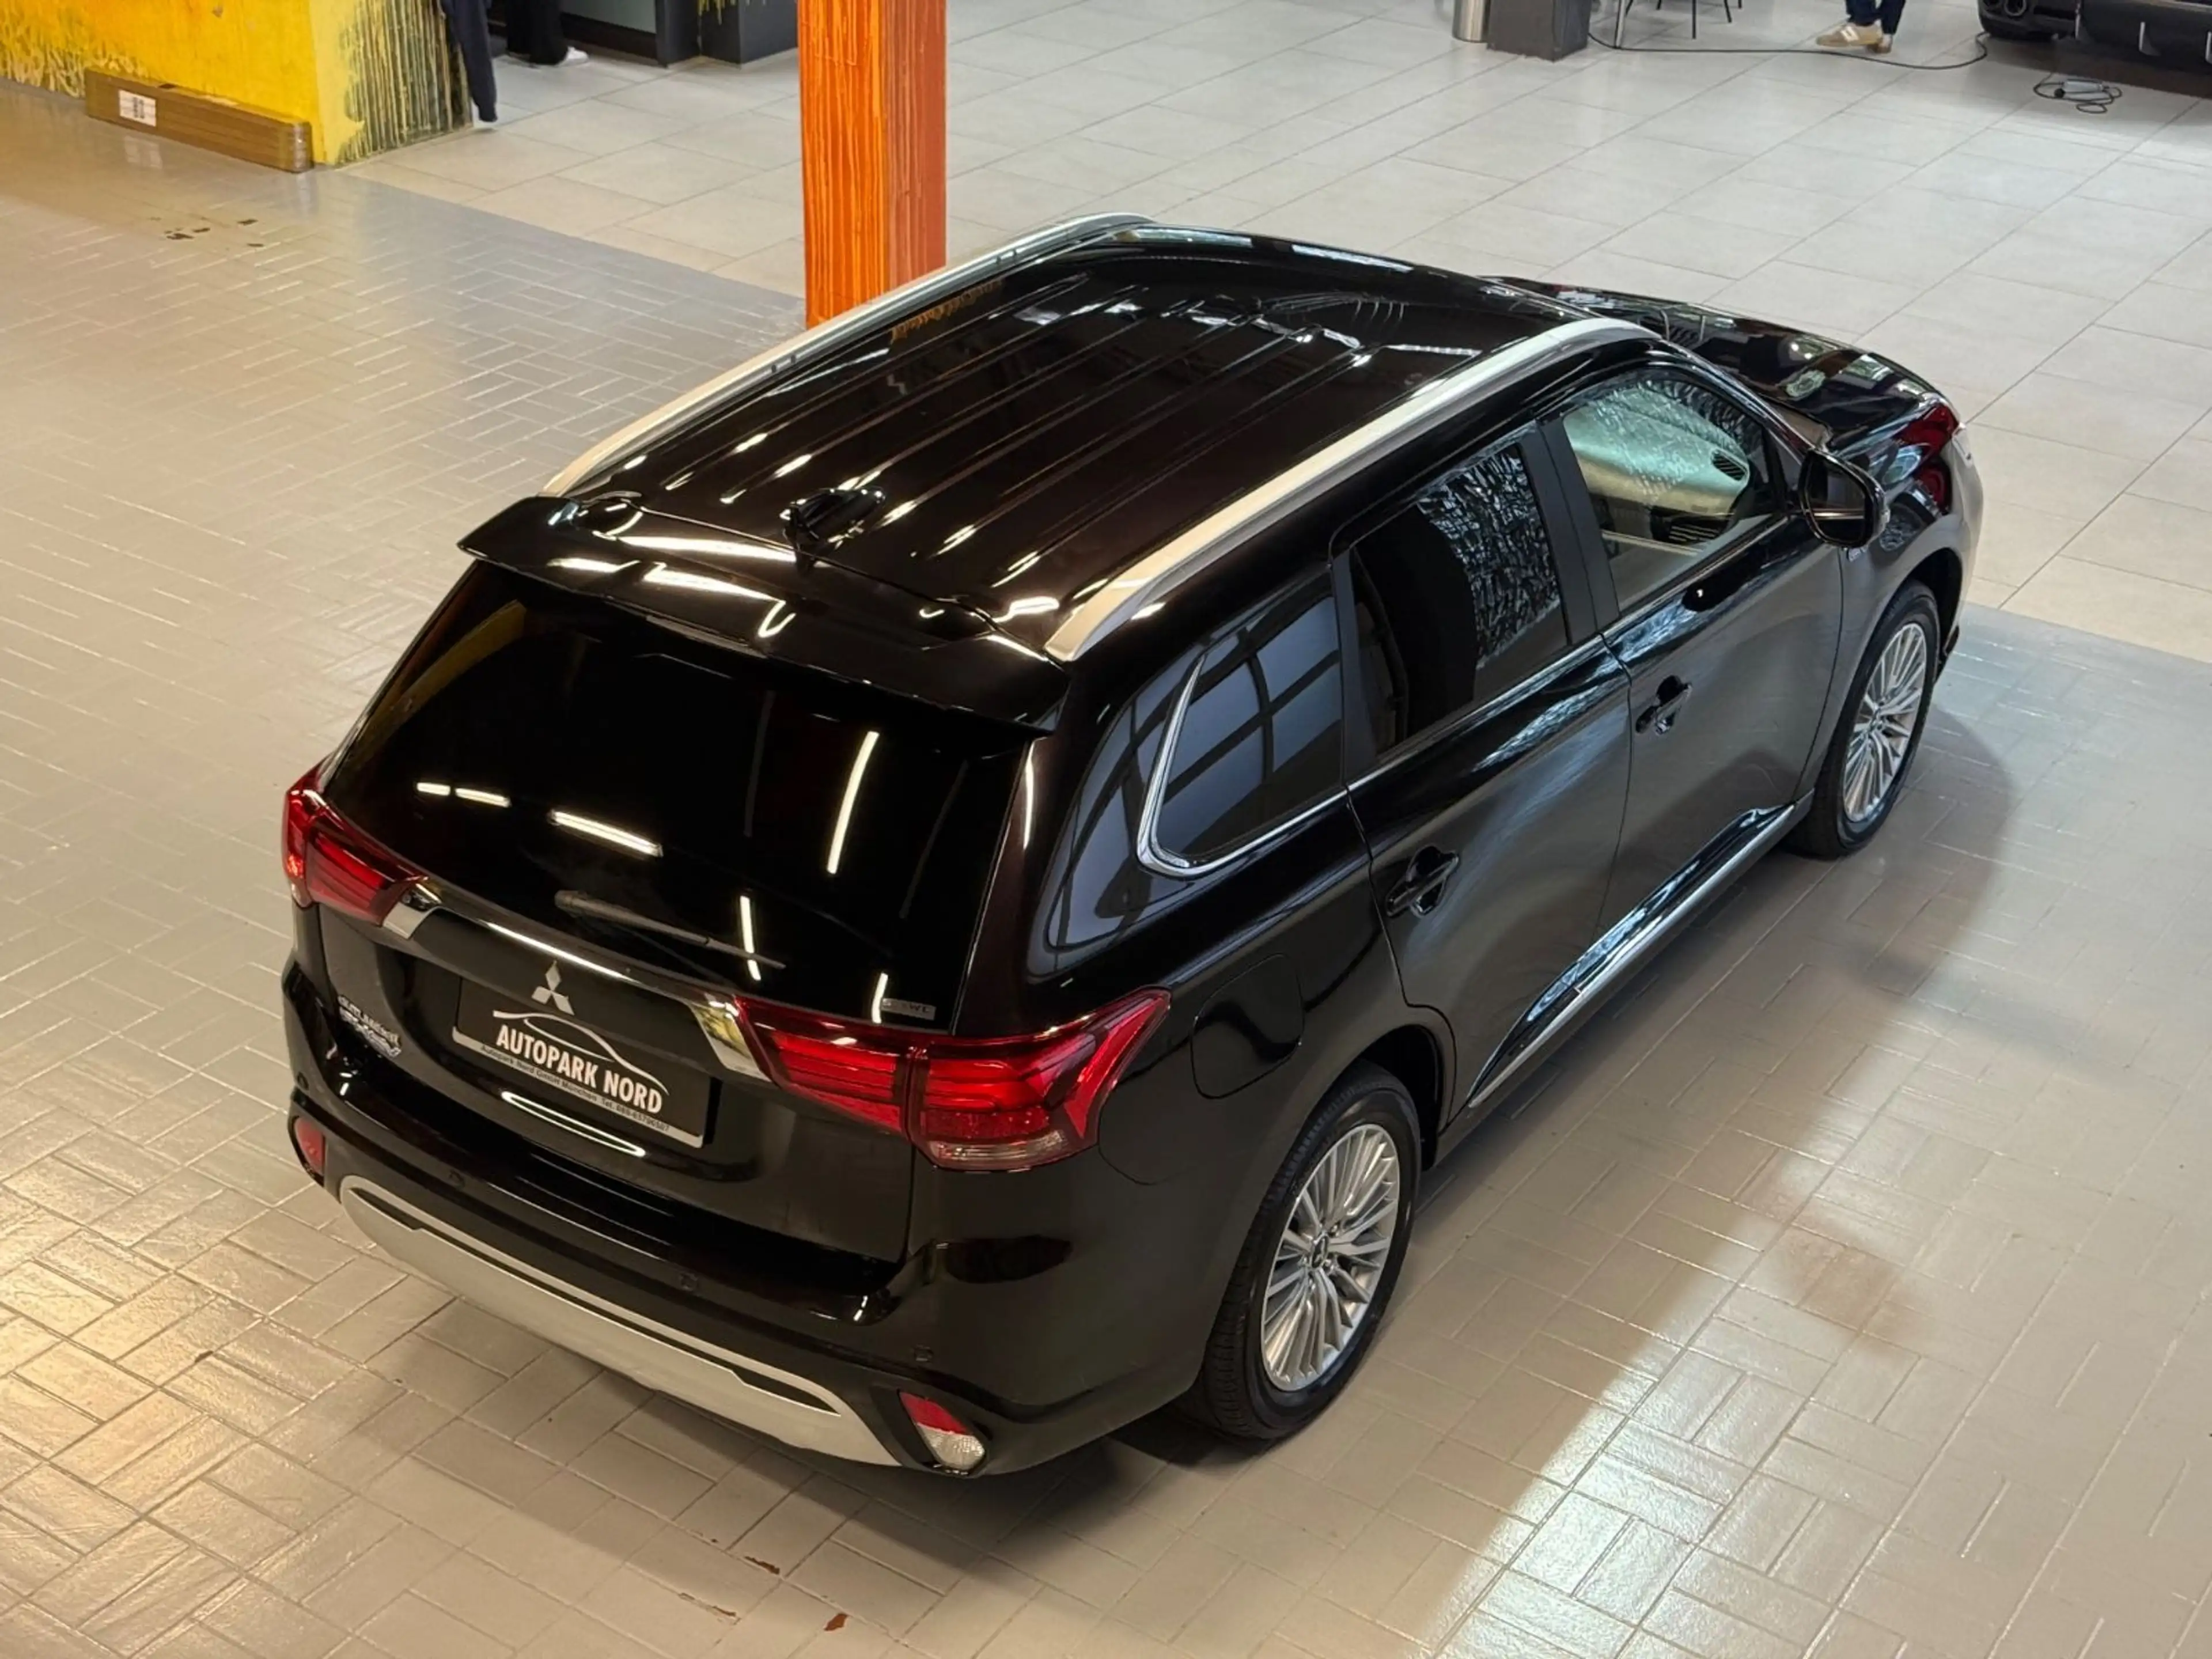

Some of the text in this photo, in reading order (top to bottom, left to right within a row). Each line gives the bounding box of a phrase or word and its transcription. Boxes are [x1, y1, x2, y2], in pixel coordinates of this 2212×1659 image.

[480, 1045, 514, 1065] Autopark
[517, 1059, 535, 1074] Nord
[497, 1025, 662, 1113] AUTOPARK NORD
